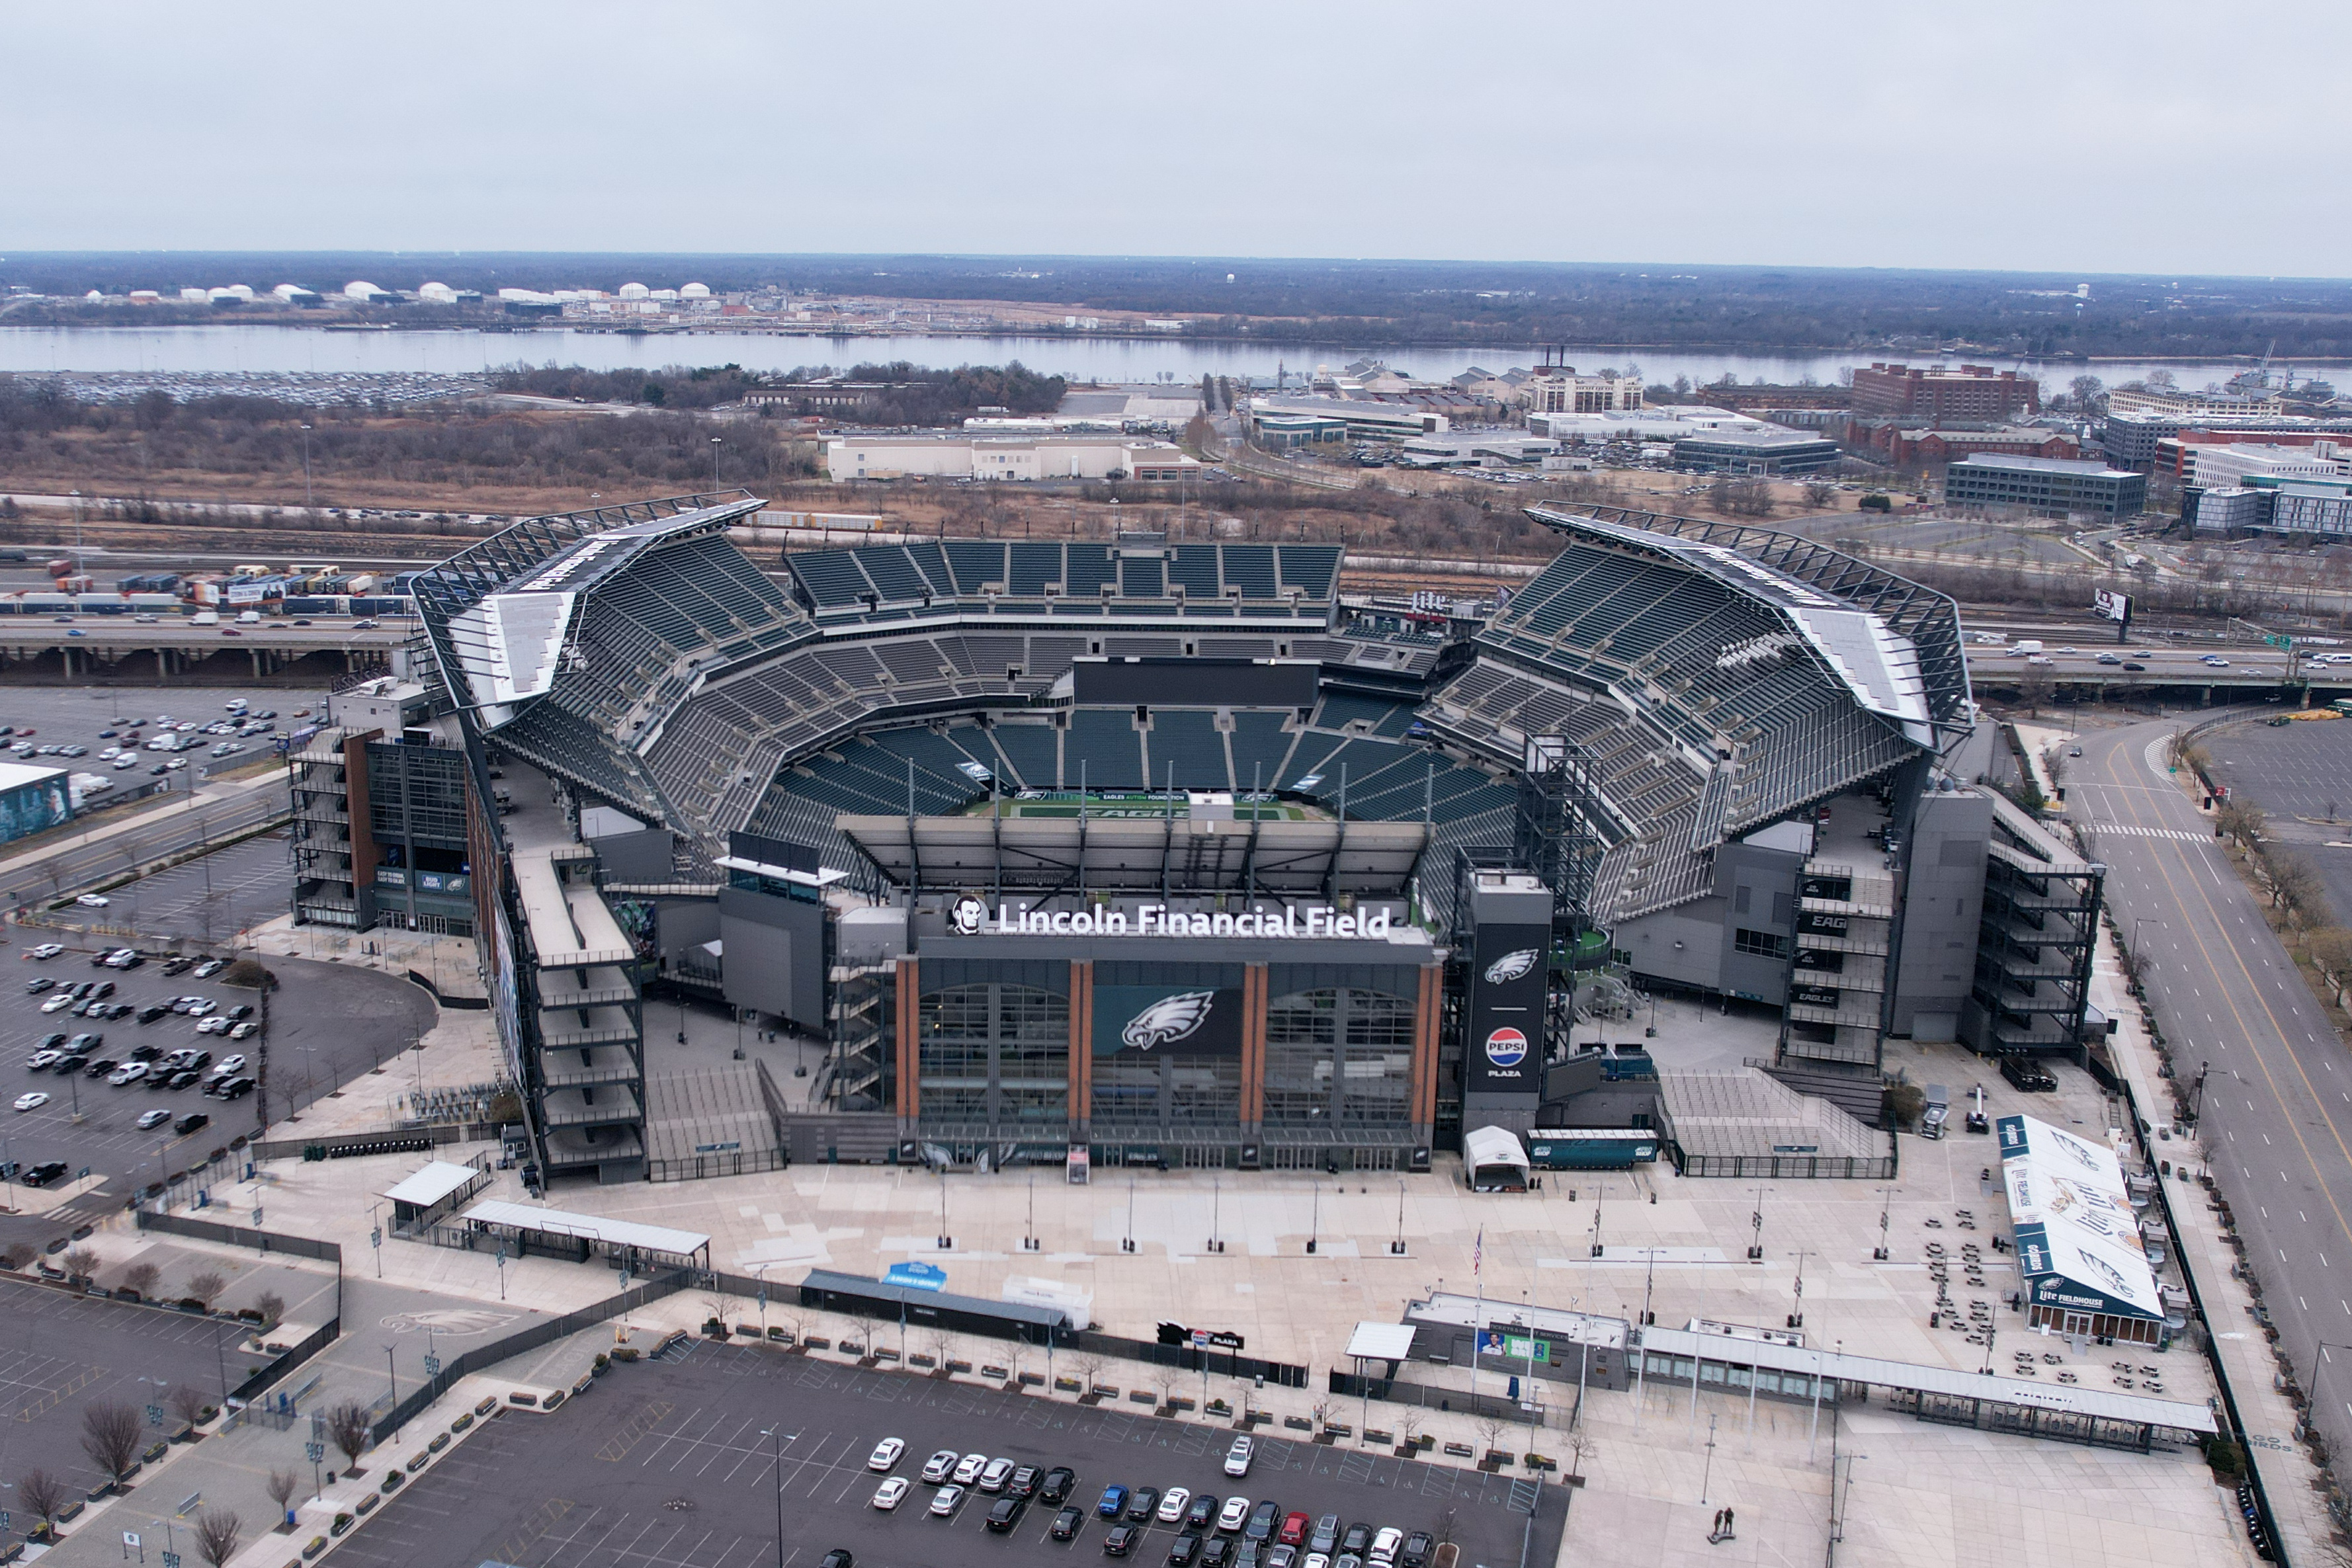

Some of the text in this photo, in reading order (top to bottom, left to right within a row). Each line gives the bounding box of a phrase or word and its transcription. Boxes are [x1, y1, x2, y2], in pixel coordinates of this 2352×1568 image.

[1411, 591, 1447, 614] Lite
[1077, 809, 1189, 818] EAGLE
[999, 903, 1390, 938] Lincoln Financial Field
[1799, 993, 1835, 1003] EAGLES
[2039, 1290, 2058, 1301] Lite
[2058, 1294, 2104, 1306] FIELDHOUSE
[1490, 1323, 1514, 1333] TICKETS
[1519, 1327, 1538, 1336] GUET
[1540, 1331, 1568, 1341] SERVICES
[1213, 1337, 1238, 1346] PLAZA
[2253, 1434, 2281, 1443] GO
